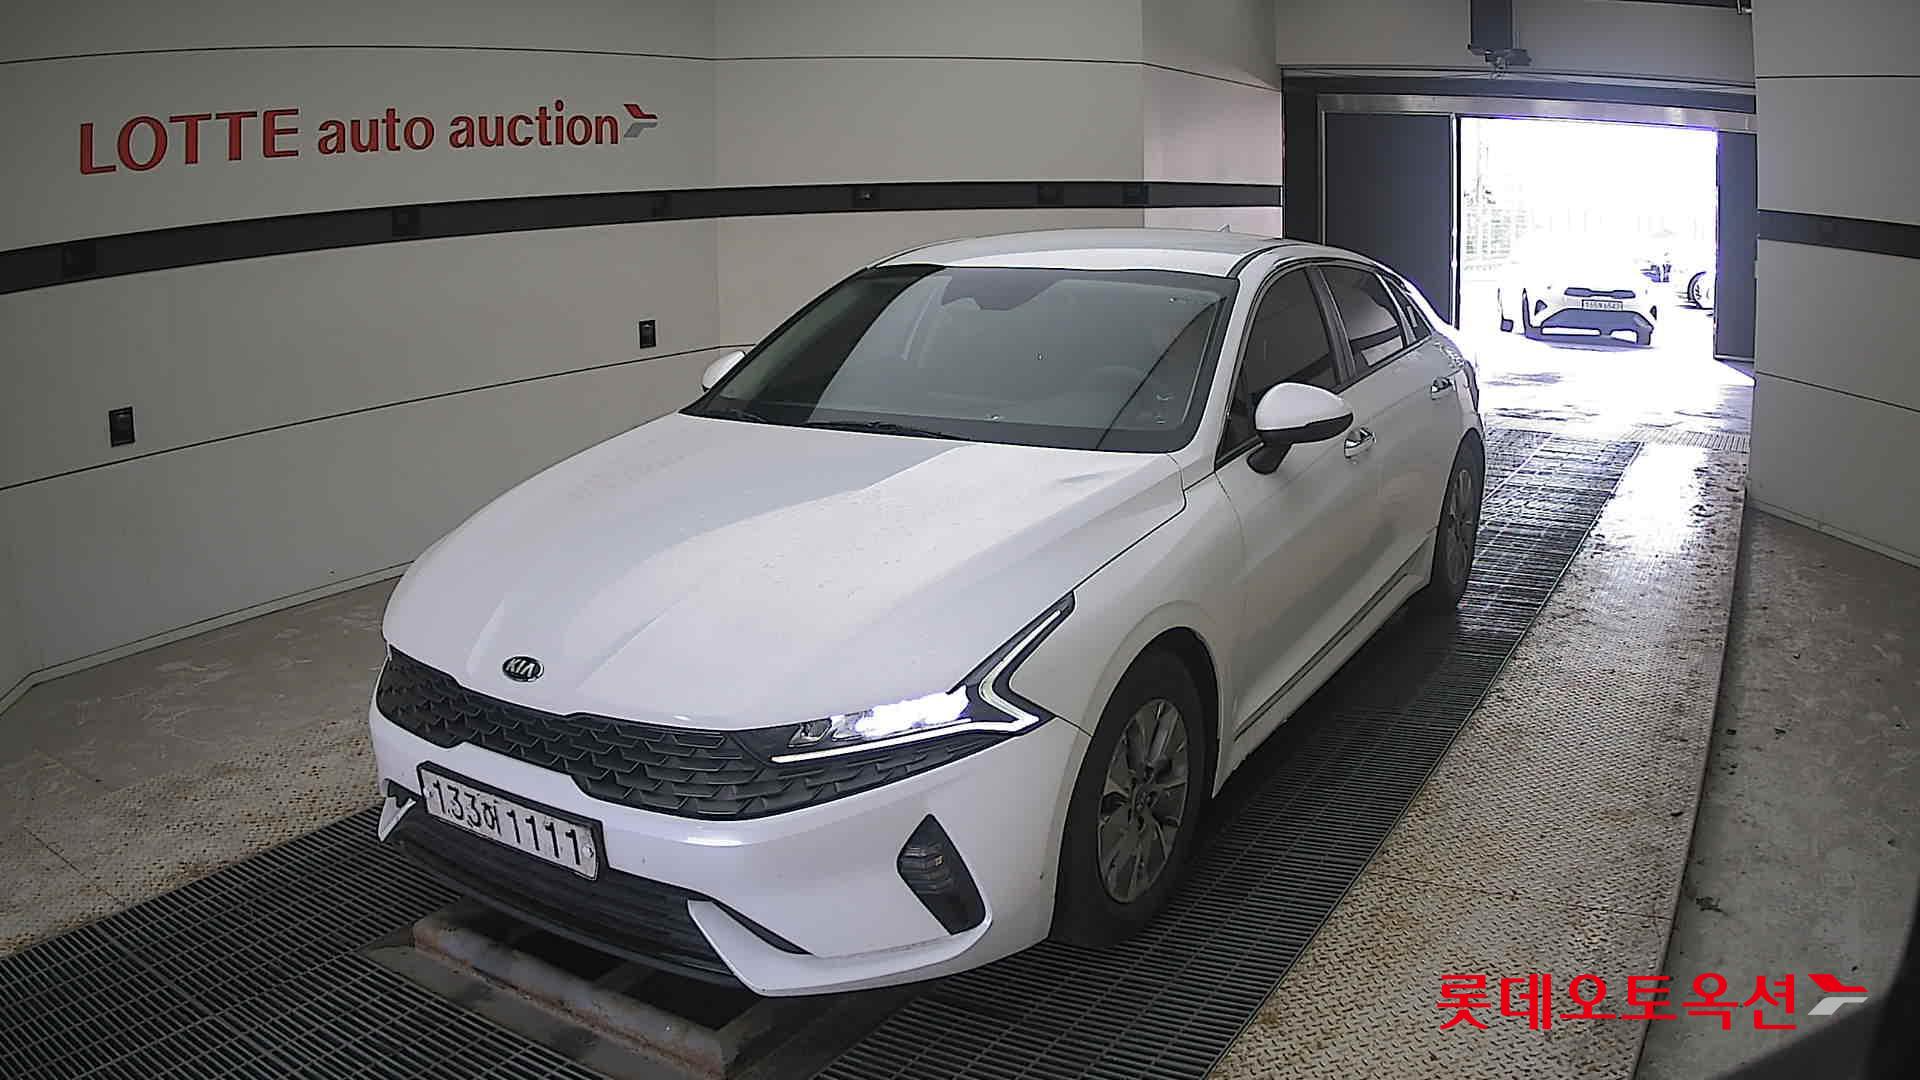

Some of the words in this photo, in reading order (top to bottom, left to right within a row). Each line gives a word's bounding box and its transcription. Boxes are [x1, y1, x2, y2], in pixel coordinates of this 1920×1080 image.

[79, 108, 299, 175] LOTTE
[317, 108, 435, 154] auto
[448, 99, 620, 149] auction
[504, 657, 538, 679] KIA
